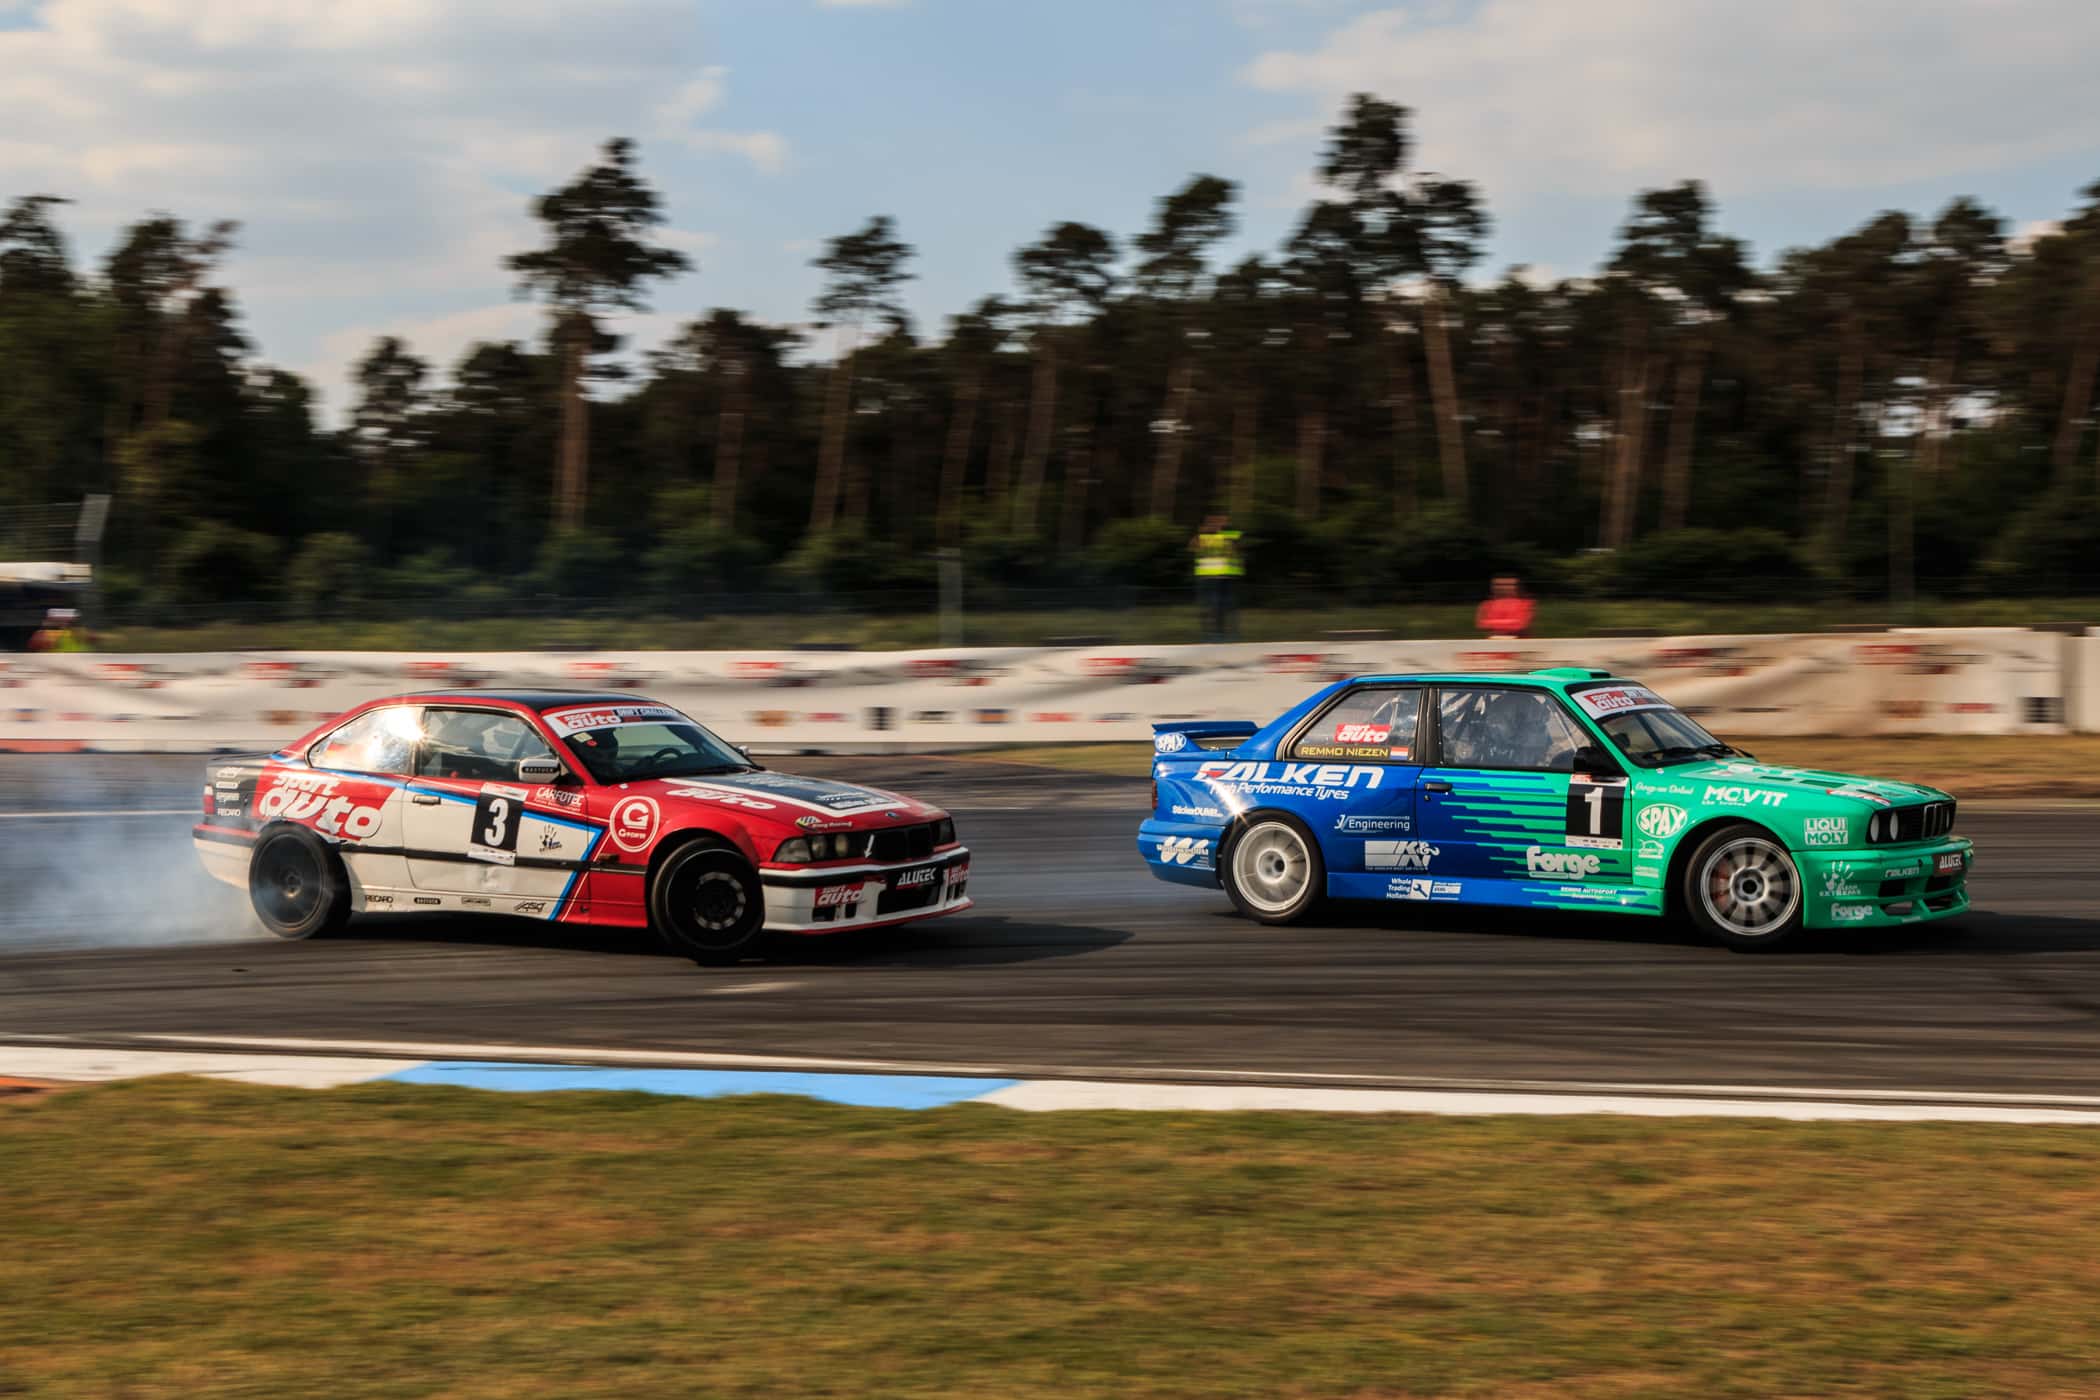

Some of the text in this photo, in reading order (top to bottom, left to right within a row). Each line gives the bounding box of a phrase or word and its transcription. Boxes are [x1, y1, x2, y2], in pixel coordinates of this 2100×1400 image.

[1597, 696, 1635, 708] auto
[567, 715, 622, 729] auto
[1337, 729, 1388, 742] auto
[1300, 746, 1388, 757] REMMO NIEZEN
[273, 771, 339, 795] sport
[1192, 761, 1385, 790] FALKEN
[666, 787, 776, 810] auto
[1237, 784, 1313, 798] Performance
[1315, 785, 1350, 800] Tyres
[259, 786, 383, 838] auto
[1584, 787, 1604, 835] 1
[484, 798, 509, 847] 3
[1348, 819, 1411, 831] Engineering
[1639, 806, 1686, 835] SPAX
[1805, 817, 1847, 831] LIQUI
[1806, 831, 1847, 844] MOLY
[897, 867, 937, 886] ALUTEC
[817, 888, 864, 906] auto
